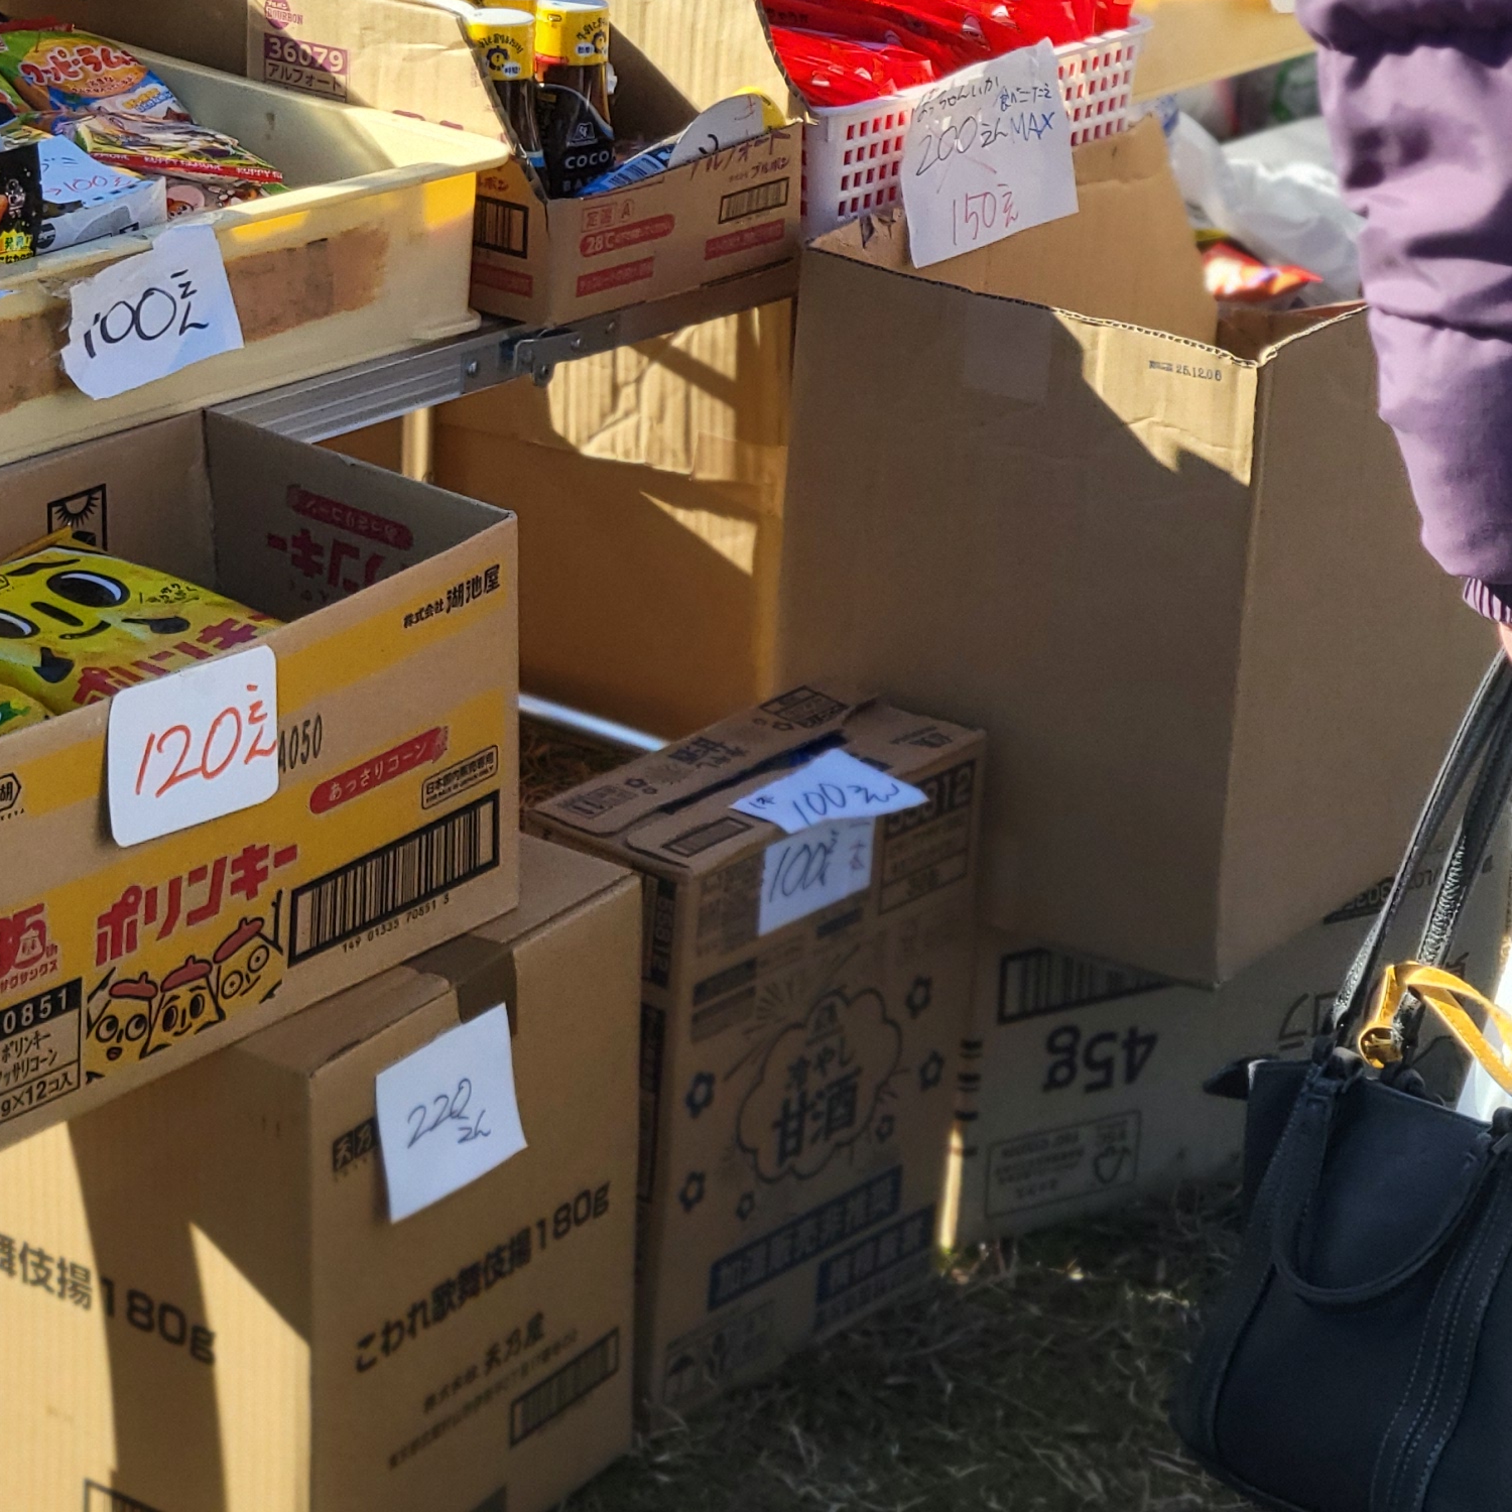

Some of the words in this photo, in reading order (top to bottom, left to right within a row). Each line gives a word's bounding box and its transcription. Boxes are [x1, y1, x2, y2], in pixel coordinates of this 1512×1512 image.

[266, 8, 304, 26] BOURBON
[267, 61, 342, 91] アルフォート
[269, 39, 344, 74] 36079
[1010, 111, 1056, 143] MAX
[445, 563, 502, 616] 湖池屋
[329, 738, 430, 802] あっさりコーン
[95, 844, 299, 968] ポリンキー
[0, 1030, 52, 1065] ポリンキー
[772, 1074, 864, 1168] 甘酒
[354, 1180, 611, 1375] こわれ歌舞伎揚180g
